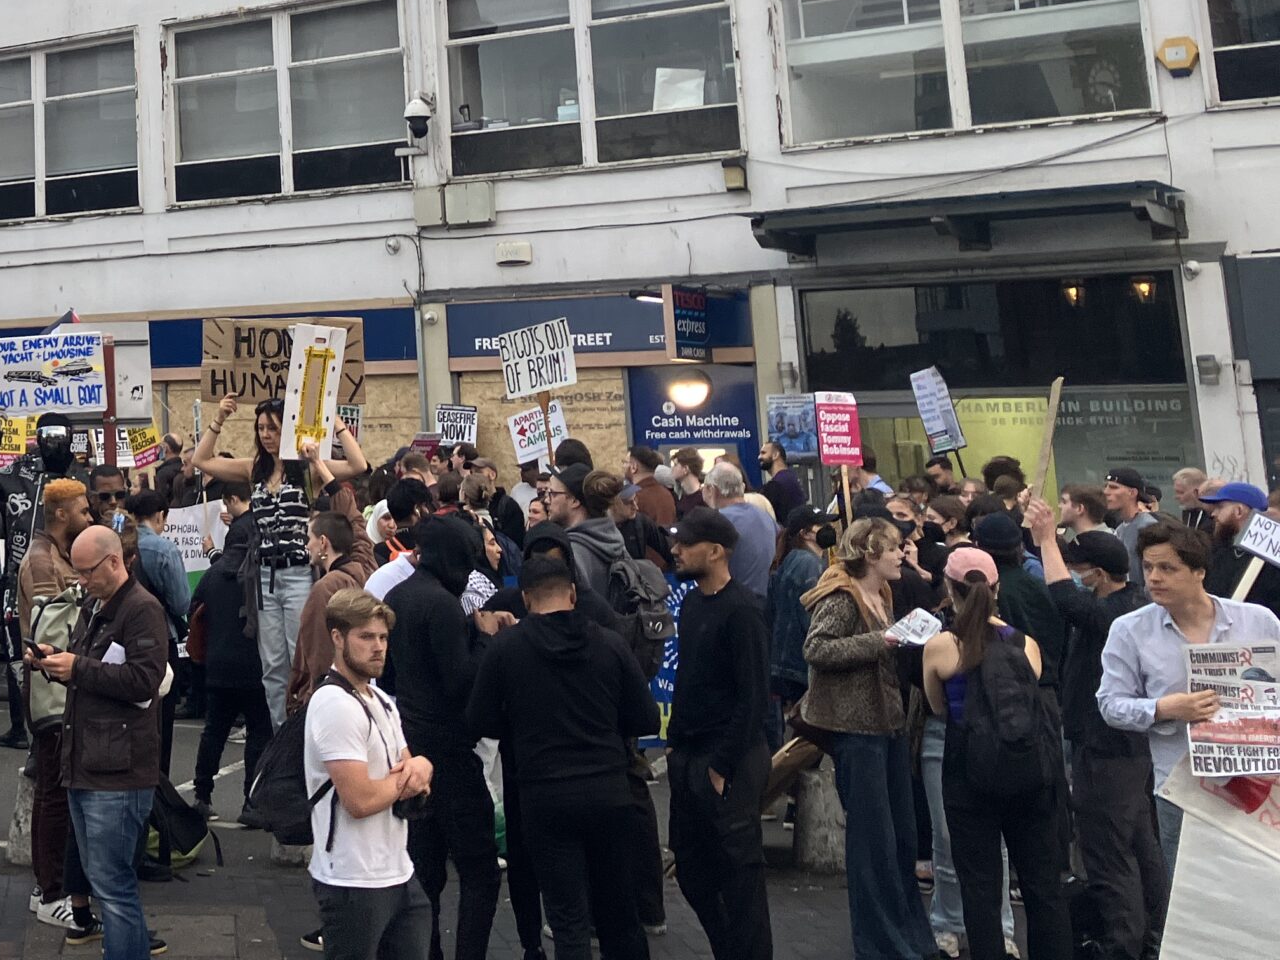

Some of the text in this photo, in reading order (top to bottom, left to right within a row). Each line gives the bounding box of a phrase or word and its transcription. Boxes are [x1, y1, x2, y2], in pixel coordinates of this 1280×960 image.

[673, 291, 705, 310] TESCO
[676, 317, 706, 337] express
[22, 336, 59, 351] ENEMY
[499, 319, 570, 362] BIGOTS OUT
[1, 351, 34, 365] YACHT
[43, 346, 95, 362] LIMOUSINE
[693, 346, 706, 358] CASH
[505, 351, 568, 394] OF BRUM!
[19, 389, 28, 407] A
[34, 387, 73, 406] SMALL
[78, 384, 103, 406] BOAT
[1089, 399, 1182, 412] BUILDING
[437, 411, 476, 425] CEASEFIRE
[651, 414, 739, 428] Cash Machine
[819, 410, 850, 423] Oppose
[1089, 415, 1138, 425] STREET
[645, 428, 751, 439] Free cash withdrawals
[821, 422, 849, 432] fascist
[4, 435, 13, 443] TO
[132, 435, 157, 453] FASCISM
[821, 433, 851, 446] Tommy
[70, 442, 88, 452] COME
[823, 444, 860, 455] Robinson
[1255, 517, 1279, 535] NOT
[173, 537, 179, 546] &
[1244, 529, 1269, 547] MY
[184, 550, 189, 559] &
[1189, 651, 1240, 665] COMMUNIST
[1203, 668, 1227, 676] TRUST
[1228, 668, 1238, 676] IN
[1192, 744, 1215, 755] JOIN
[1216, 745, 1235, 756] THE
[1237, 746, 1264, 757] FIGHT
